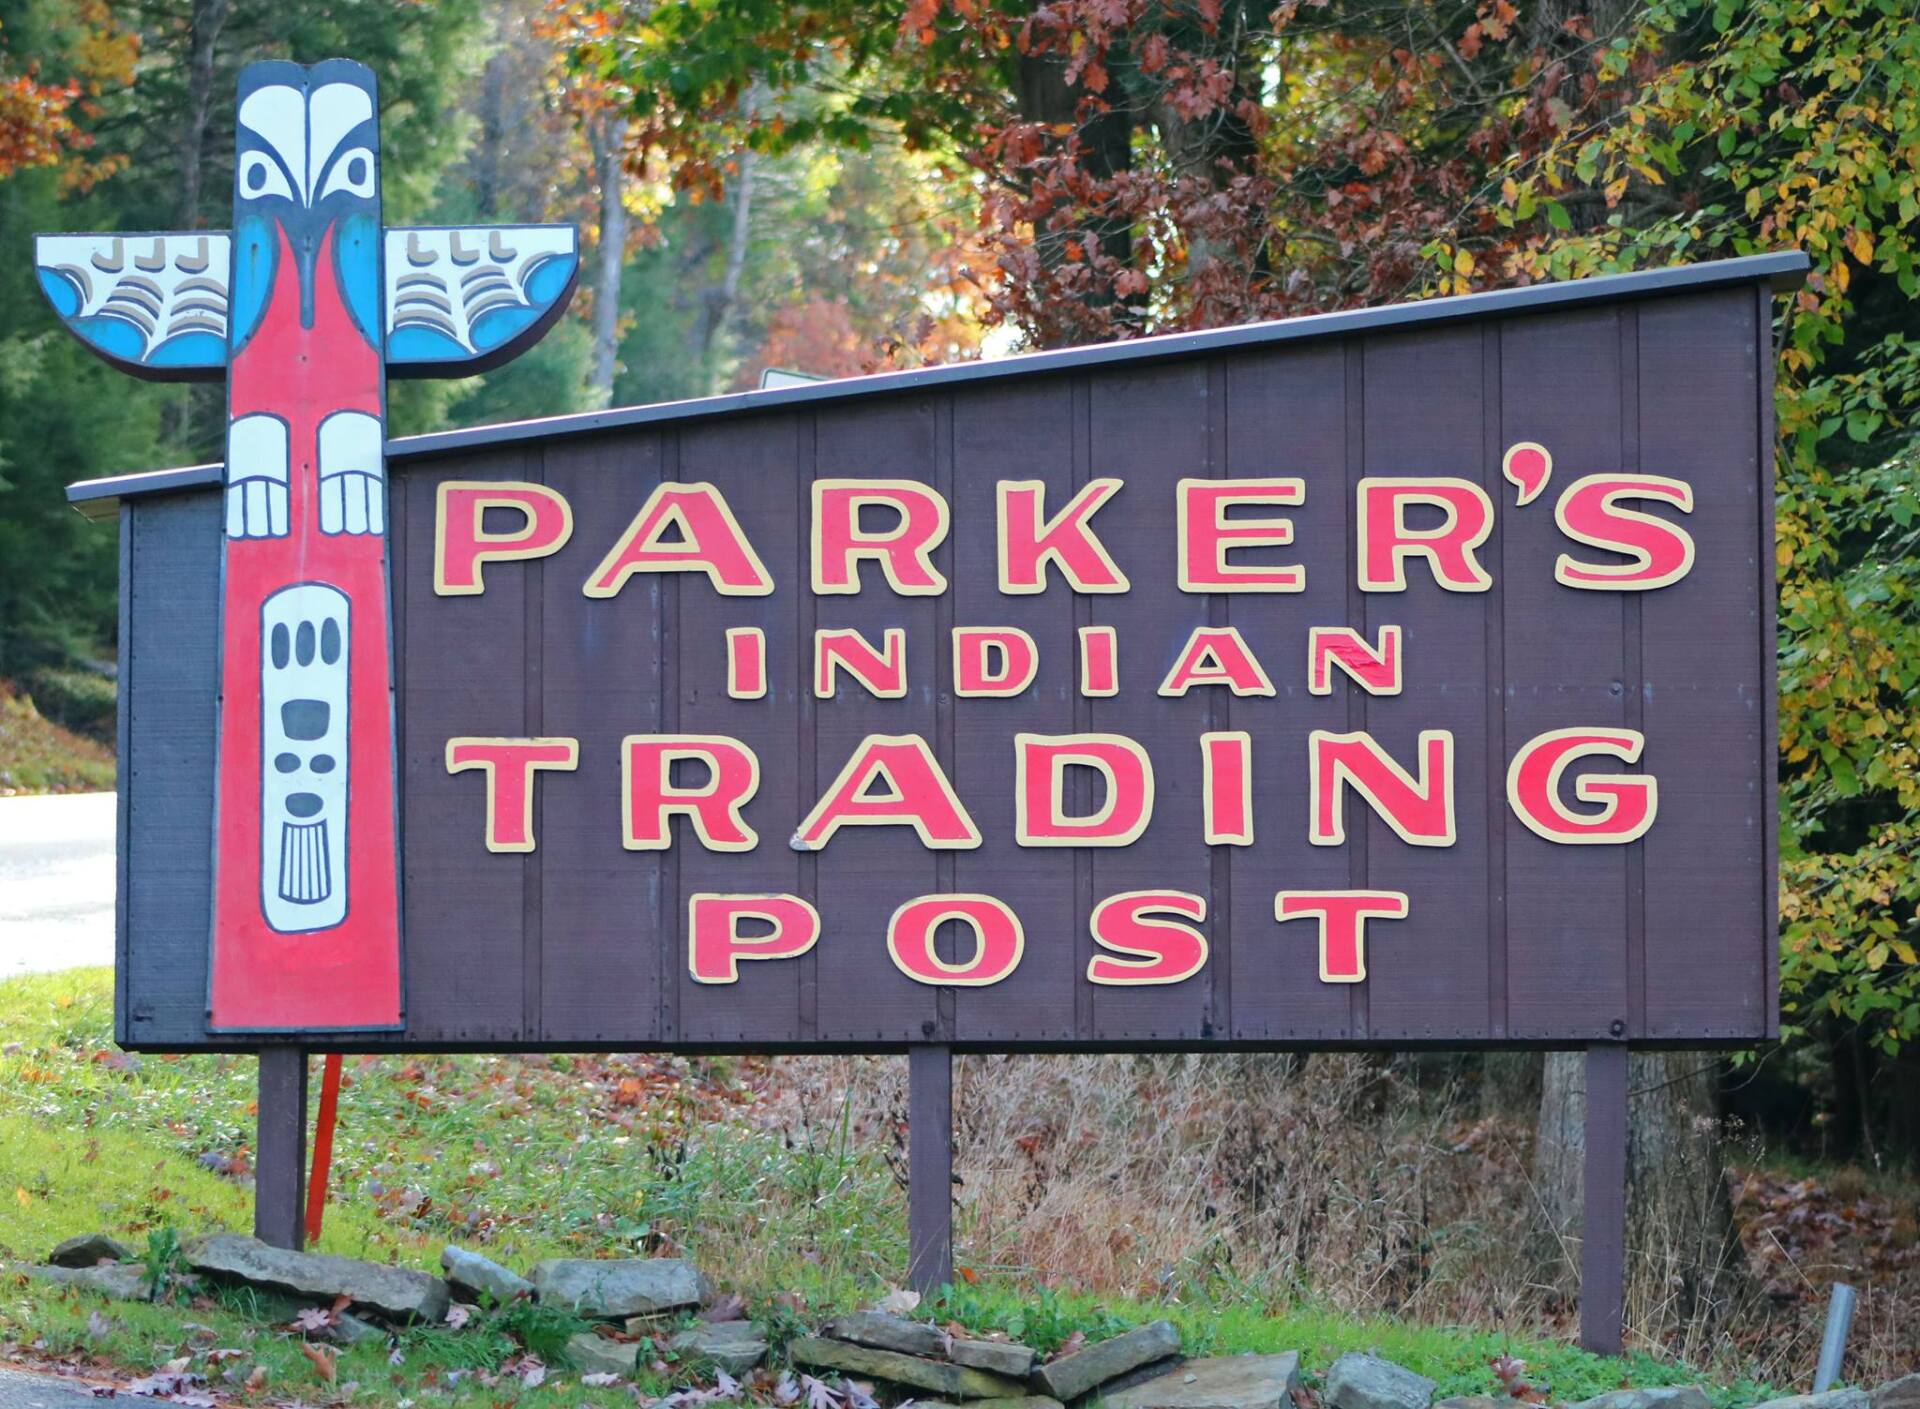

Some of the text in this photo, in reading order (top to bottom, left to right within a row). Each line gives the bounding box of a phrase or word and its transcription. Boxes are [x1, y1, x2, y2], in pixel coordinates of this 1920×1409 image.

[434, 442, 1695, 598] PARKER'S
[726, 625, 1402, 699] INDIAN
[445, 728, 1657, 852] TRADING
[689, 890, 1408, 986] POST
